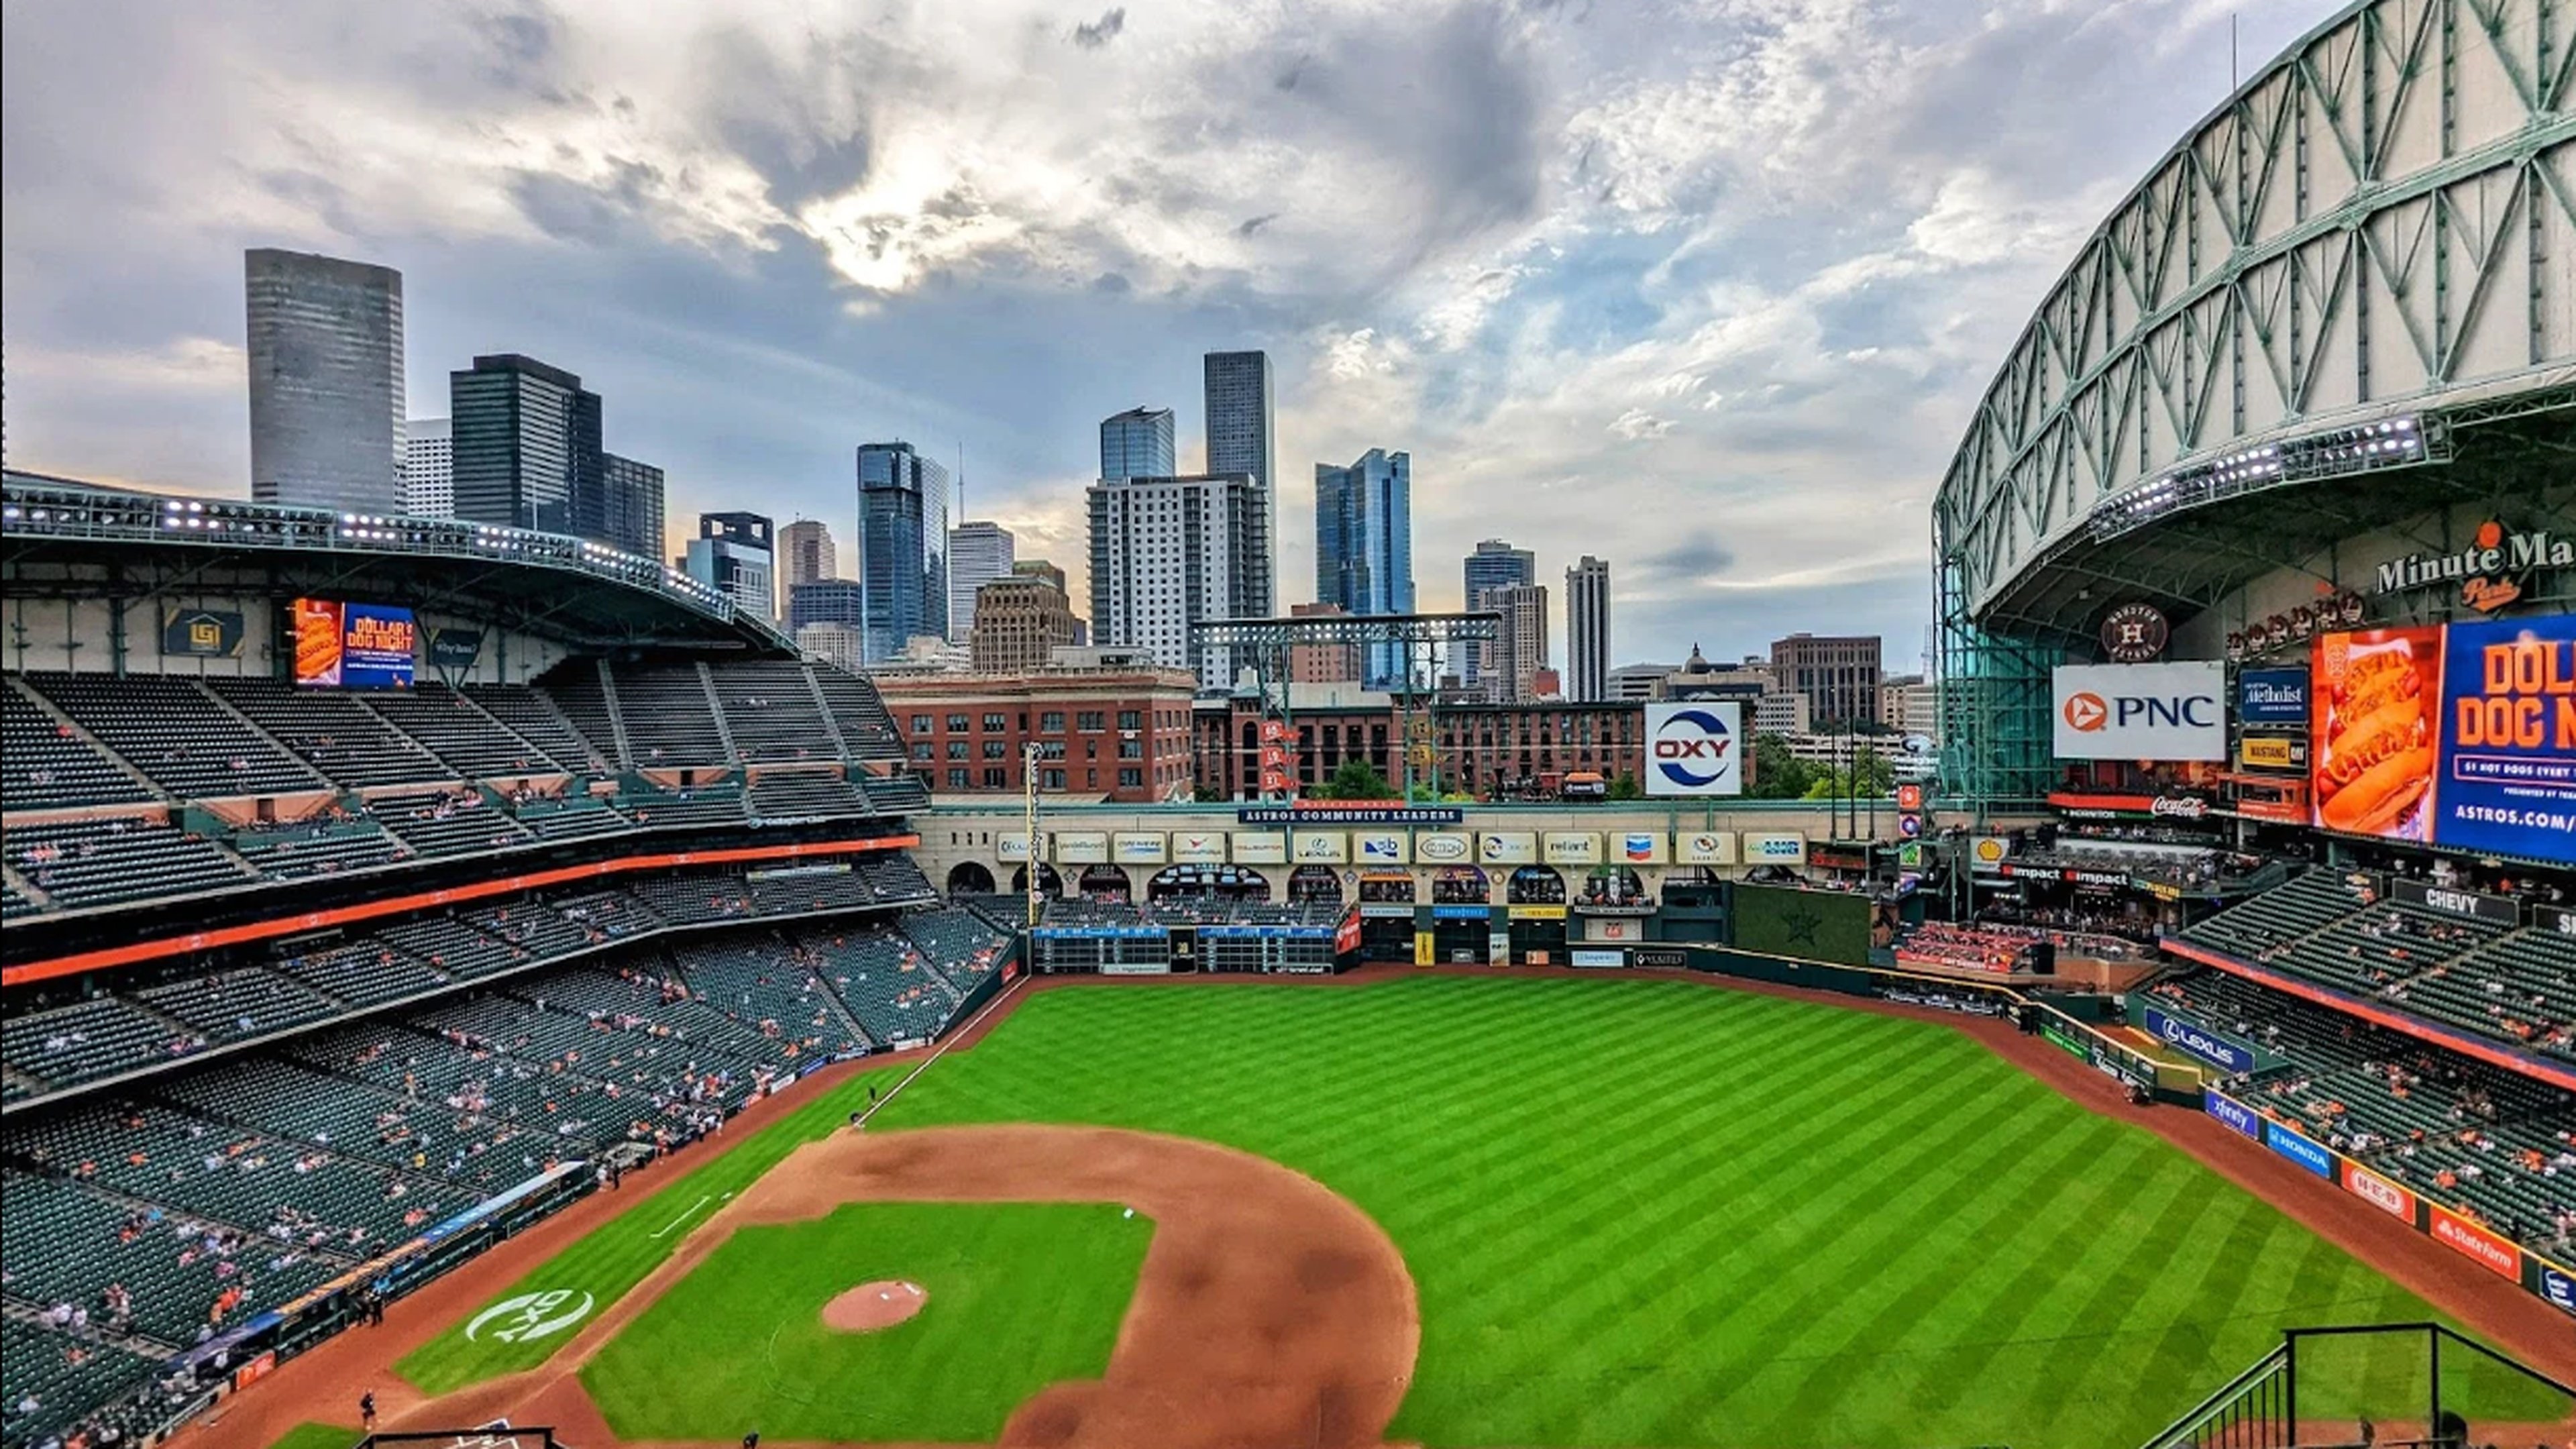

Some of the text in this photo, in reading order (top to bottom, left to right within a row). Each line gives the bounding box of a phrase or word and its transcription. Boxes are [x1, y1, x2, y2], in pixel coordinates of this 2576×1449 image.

[2377, 532, 2574, 594] Minute Ma
[2108, 606, 2158, 624] HOUSTON
[355, 618, 404, 634] DOLLAR
[2121, 623, 2144, 643] H
[347, 632, 413, 651] DOG NIGHT
[2111, 645, 2157, 659] ASTROS
[2484, 641, 2576, 694] DOL
[2246, 684, 2303, 704] Methodist
[2113, 696, 2214, 727] PNC
[2457, 697, 2543, 748] DOG
[1655, 739, 1731, 759] OXY
[2251, 746, 2286, 759] MUSTANG
[2480, 763, 2501, 773] HOT
[2504, 765, 2533, 776] DOGS
[2537, 767, 2570, 777] EVERY
[1246, 811, 1455, 820] ASTROS COMMUNITY LEADERS
[2151, 796, 2202, 817] Coca-Cola
[1551, 841, 1589, 851] reliant
[2013, 866, 2060, 880] impact
[2076, 871, 2128, 885] impact
[2426, 889, 2478, 914] CHEVY
[2180, 1030, 2234, 1065] LEXUS
[2214, 1099, 2247, 1129] xfinity
[2282, 1134, 2328, 1168] HONDA
[2357, 1175, 2397, 1206] H-E-B
